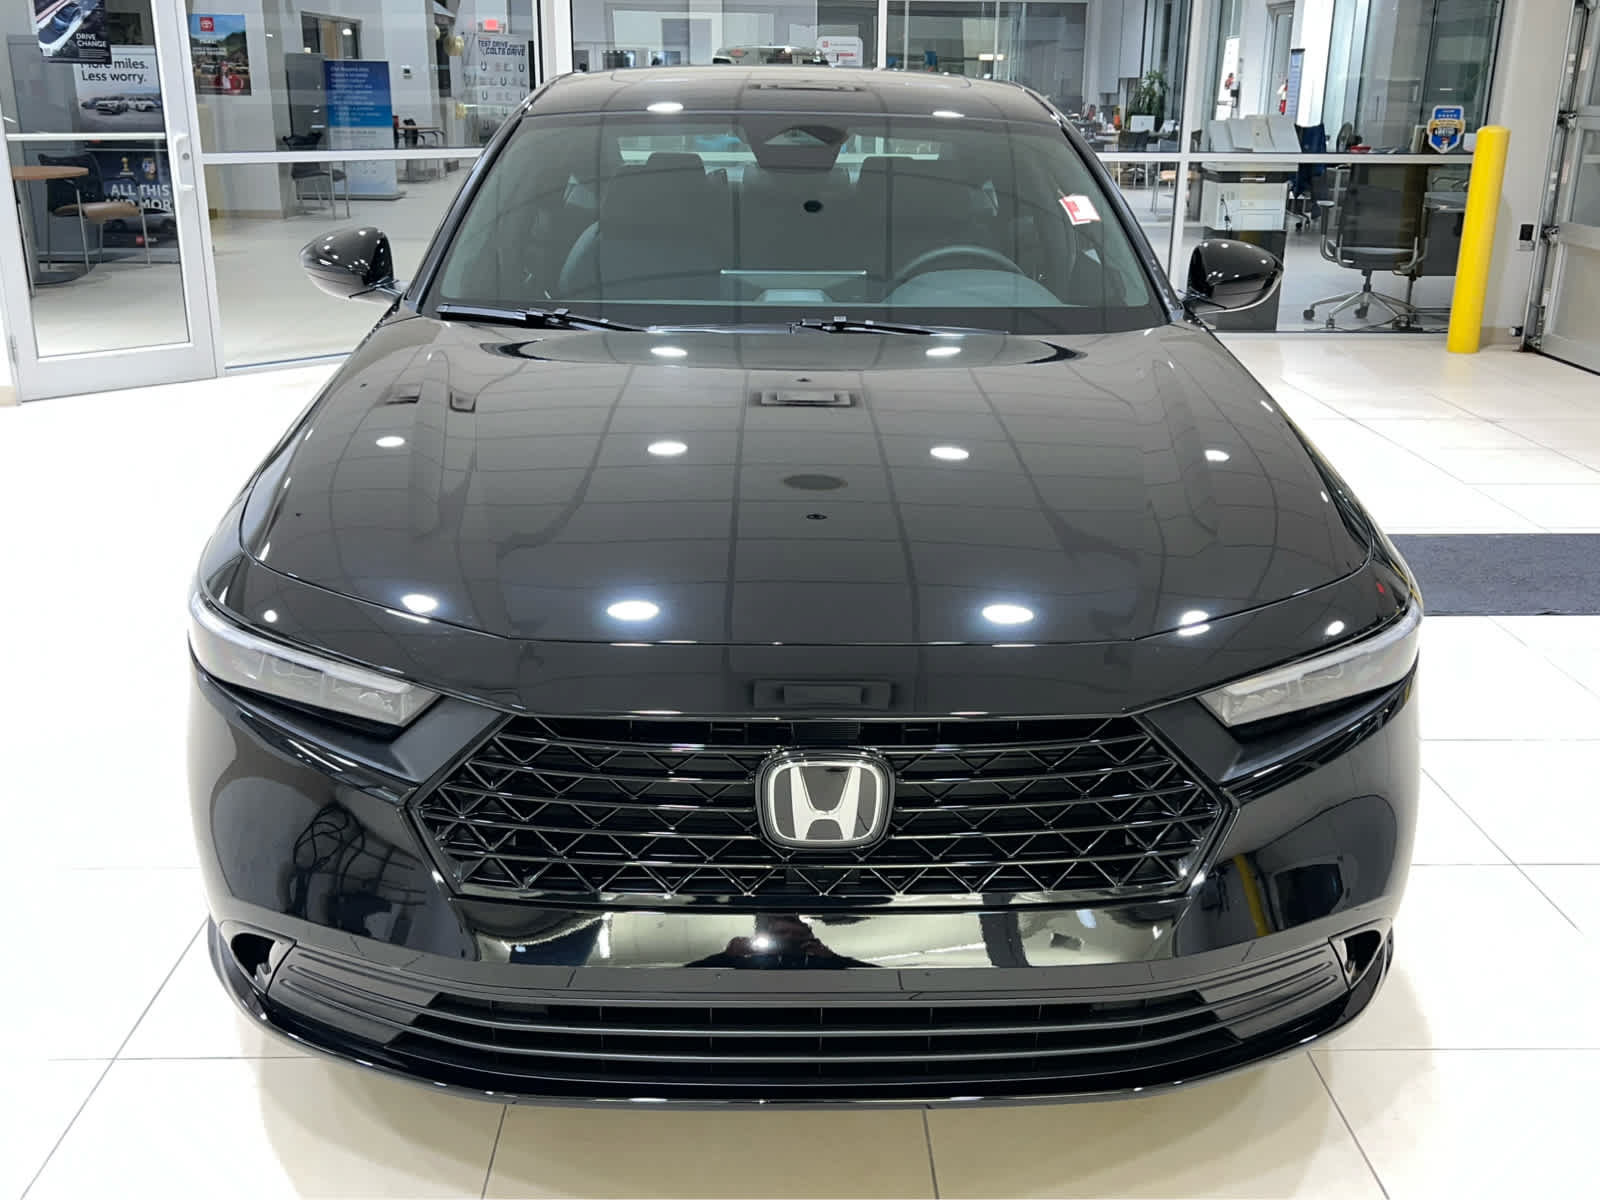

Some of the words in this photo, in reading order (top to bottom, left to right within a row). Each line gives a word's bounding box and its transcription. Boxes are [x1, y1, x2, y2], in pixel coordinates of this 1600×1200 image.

[114, 58, 149, 69] miles.
[82, 70, 107, 81] Less
[109, 73, 147, 84] worry.
[111, 184, 136, 196] ALL
[139, 184, 170, 196] THIS
[140, 199, 172, 210] MOR
